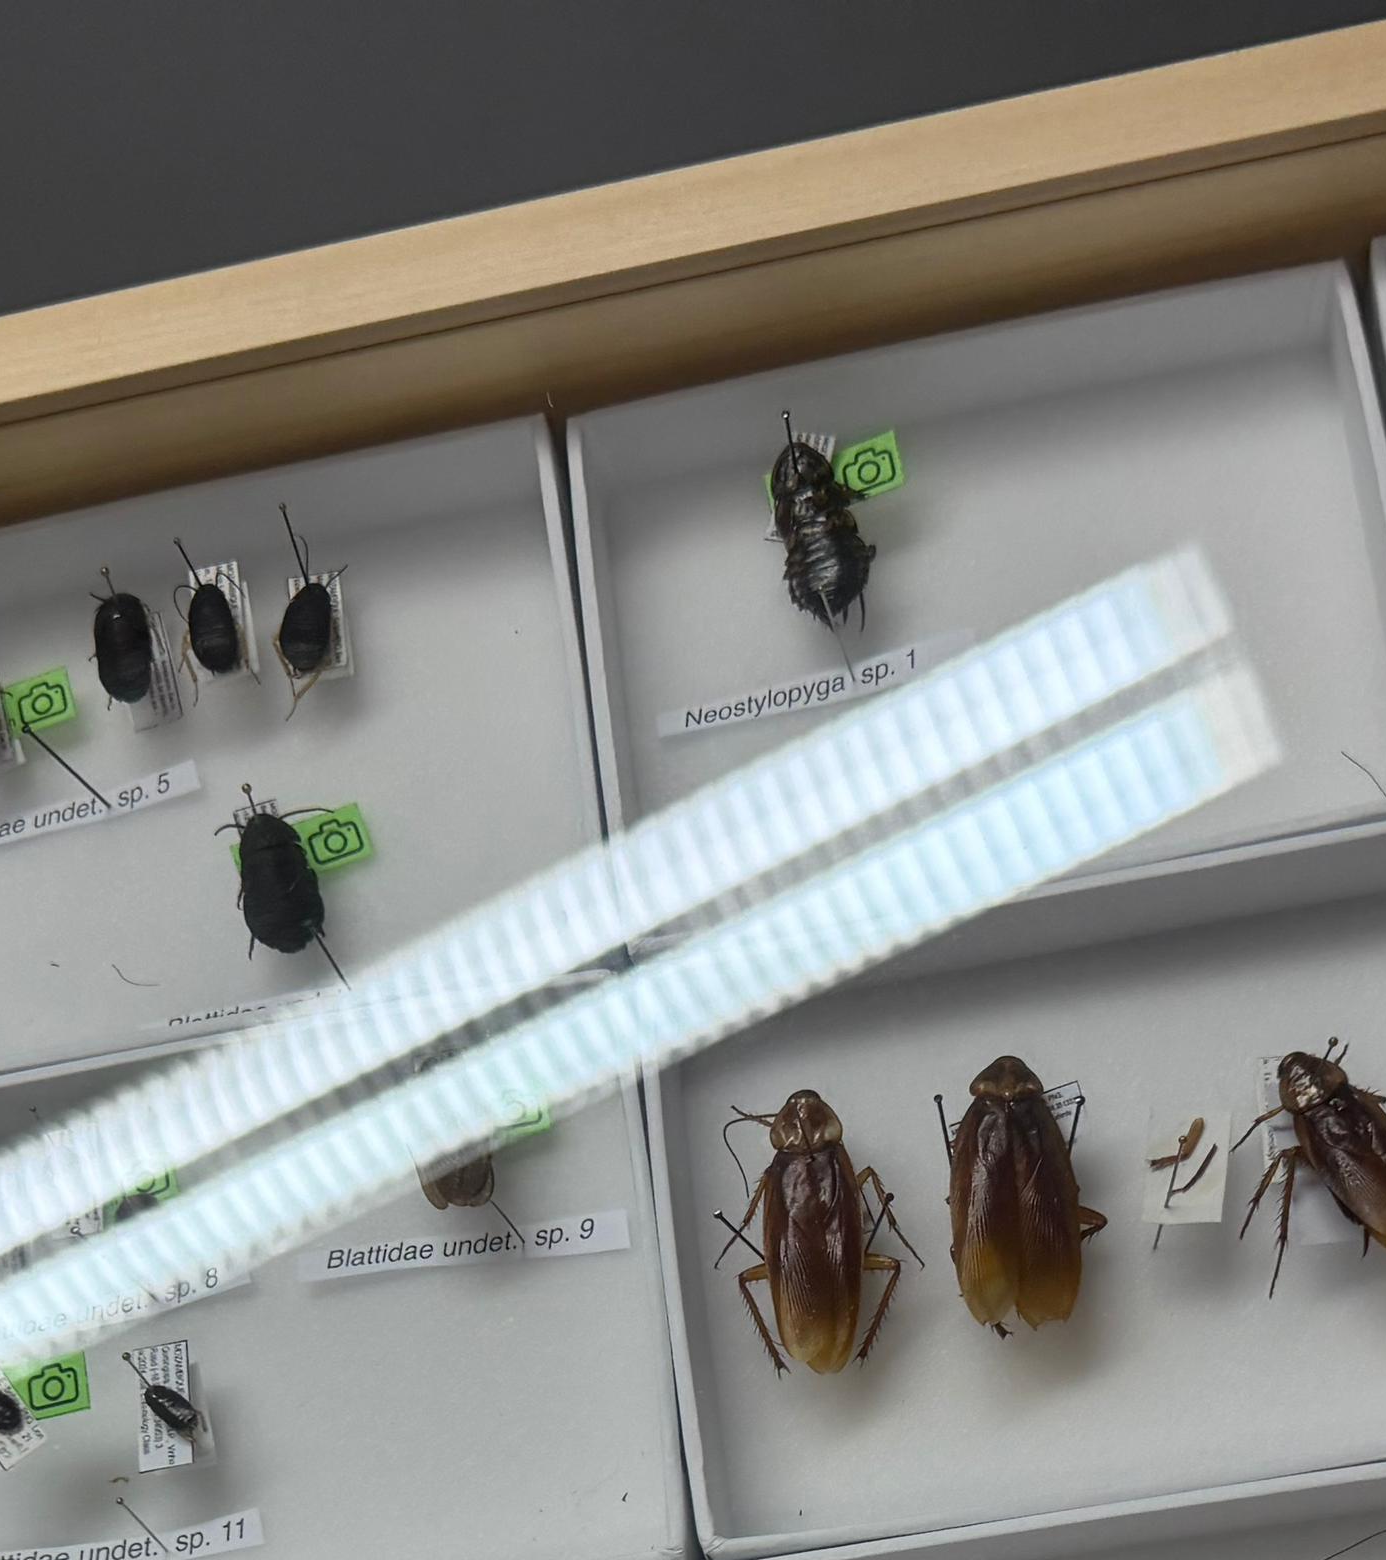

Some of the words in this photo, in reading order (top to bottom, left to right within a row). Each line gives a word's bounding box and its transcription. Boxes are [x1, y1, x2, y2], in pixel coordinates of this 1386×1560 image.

[685, 674, 845, 728] Neostylopyga
[860, 663, 895, 686] sp.
[905, 649, 915, 669] 1
[34, 798, 103, 829] undet.
[117, 785, 149, 809] sp.
[157, 772, 171, 794] 5
[327, 1243, 434, 1269] Blattidae
[443, 1232, 517, 1258] undet.
[535, 1225, 570, 1249] sp.
[580, 1218, 596, 1240] 9
[163, 1279, 197, 1303] sp.
[205, 1267, 219, 1288] 8
[175, 1530, 210, 1555] sp.
[221, 1518, 247, 1542] 11
